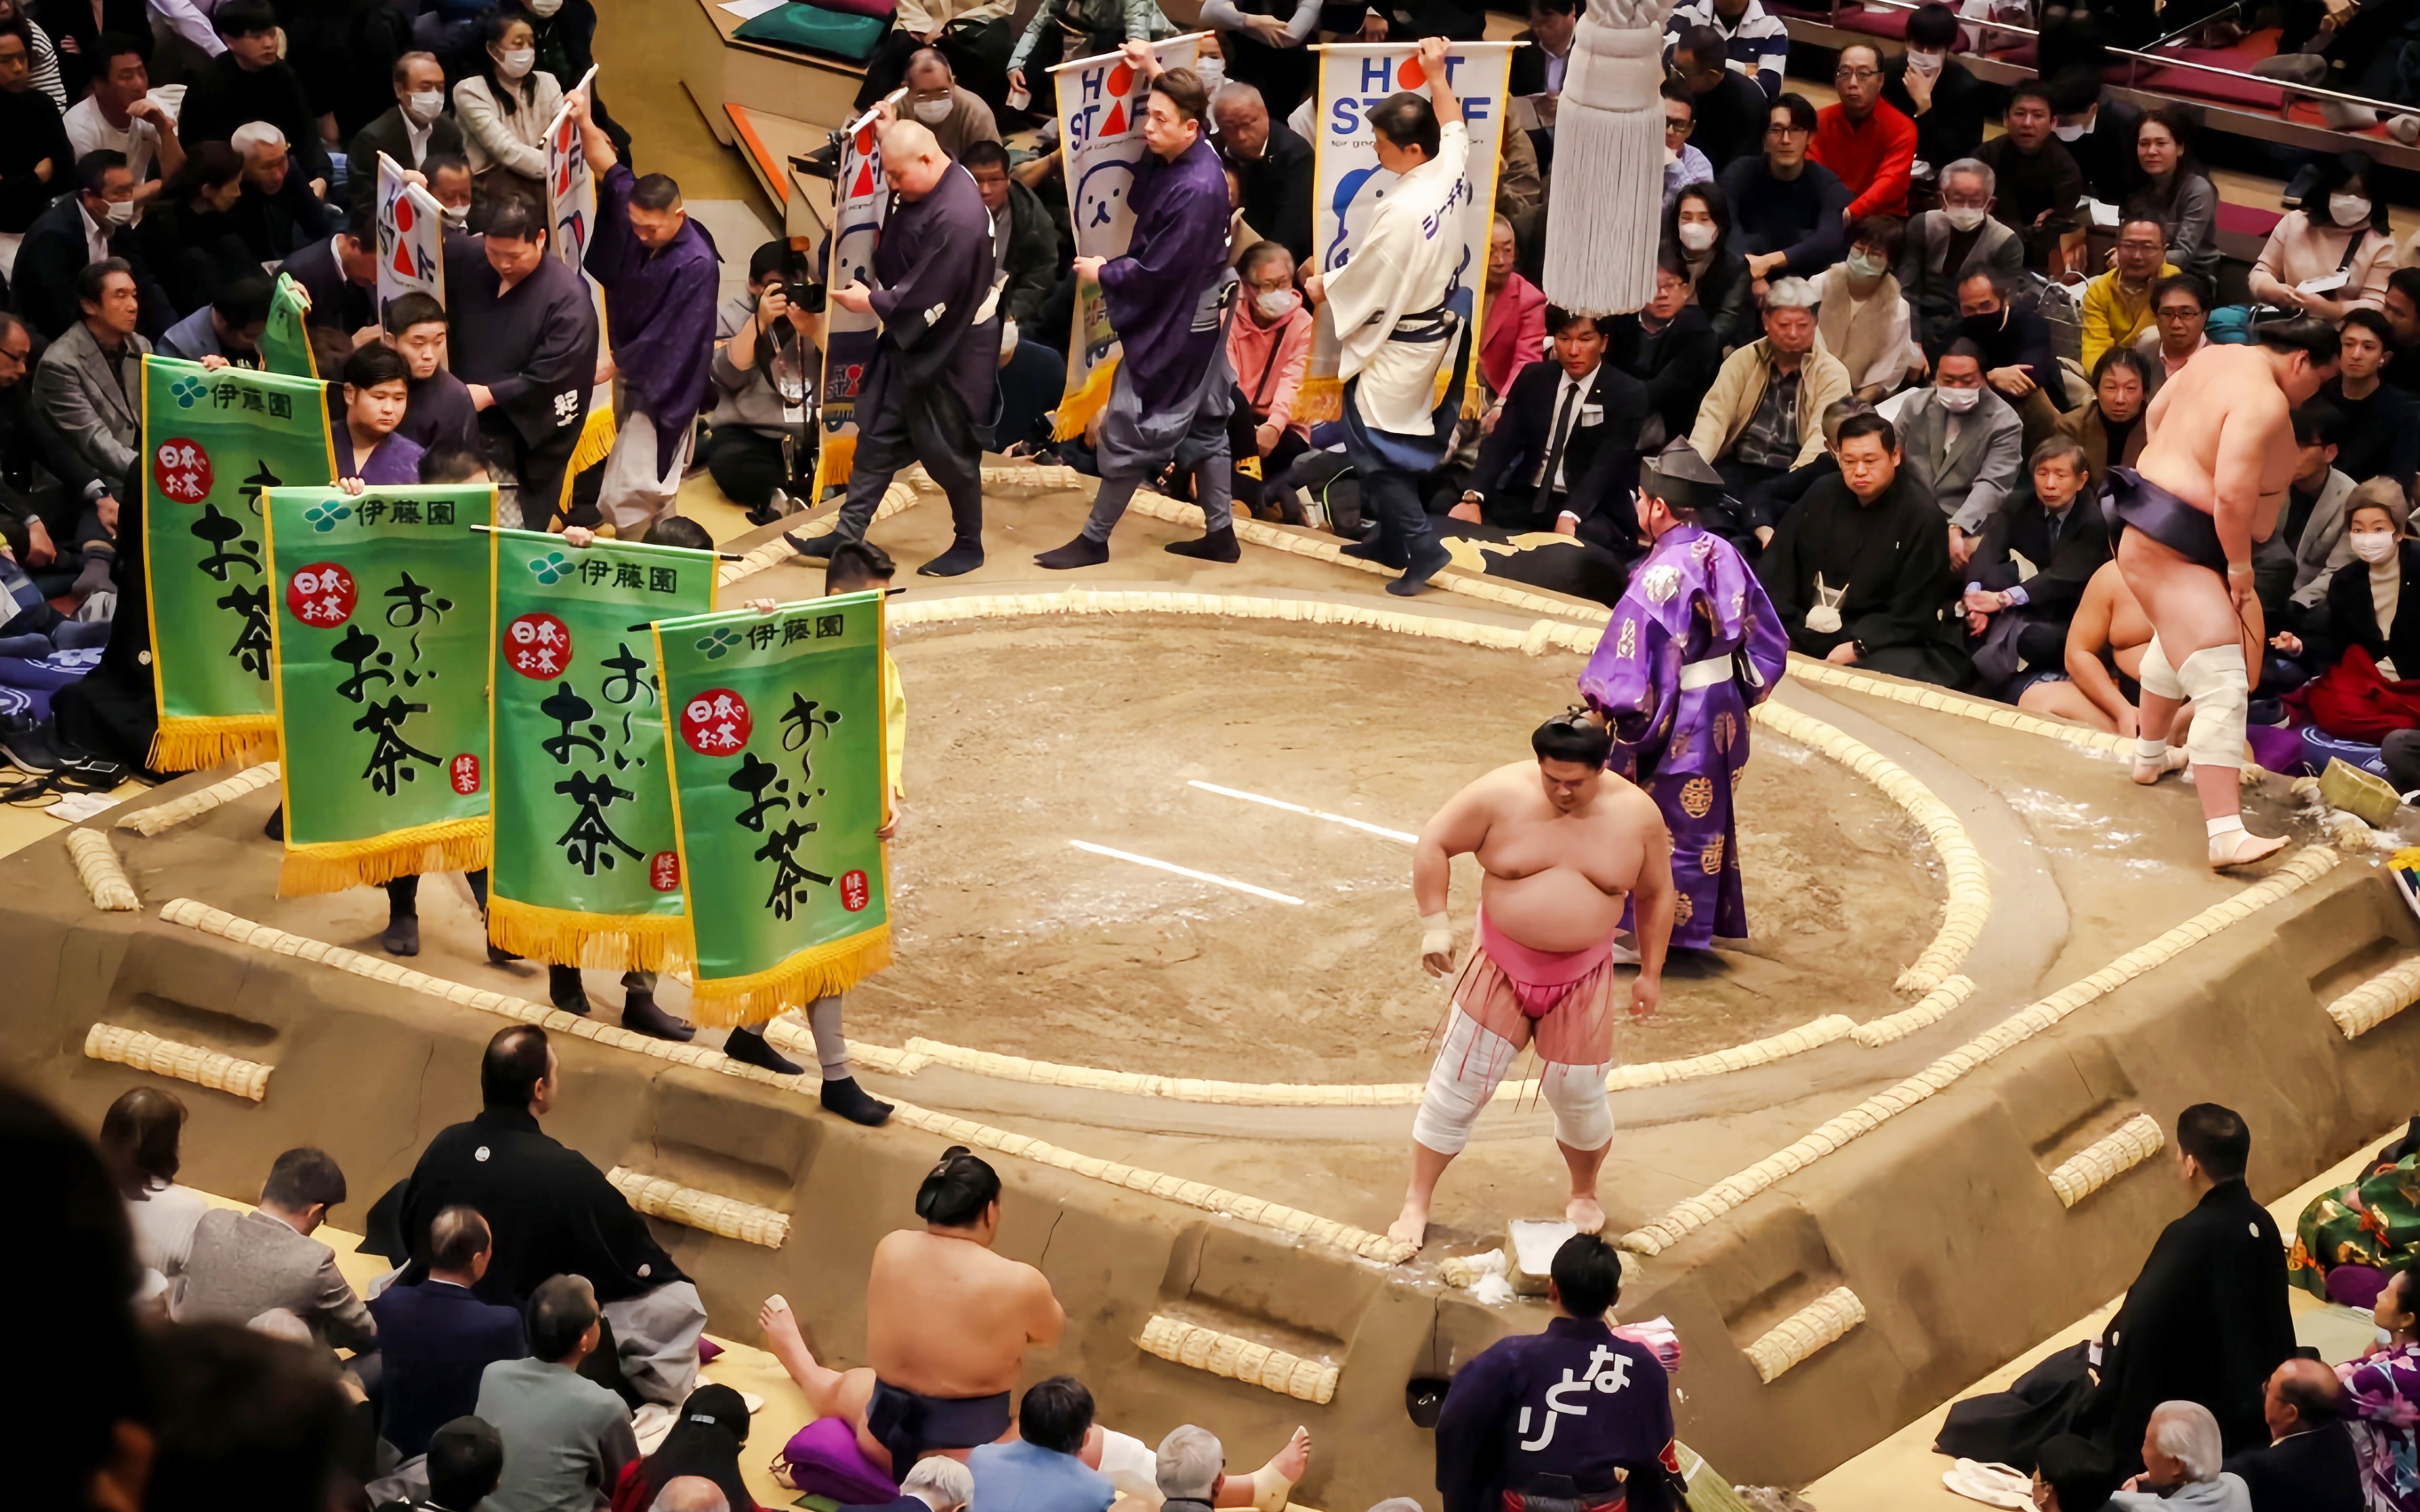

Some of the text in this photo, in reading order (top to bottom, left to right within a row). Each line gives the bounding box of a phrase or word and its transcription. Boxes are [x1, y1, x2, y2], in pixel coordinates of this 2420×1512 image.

[1070, 94, 1151, 151] STAF
[1422, 171, 1466, 240] シーチキ
[356, 500, 455, 527] 伊藤園
[578, 559, 676, 593] 伊藤園
[302, 595, 347, 621] お茶
[746, 614, 843, 650] 伊藤園
[517, 647, 560, 674] お茶
[331, 624, 444, 796] お茶
[697, 721, 742, 748] お茶
[540, 681, 646, 875] お茶
[728, 752, 834, 921] お茶
[1518, 1344, 1633, 1451] なとり
